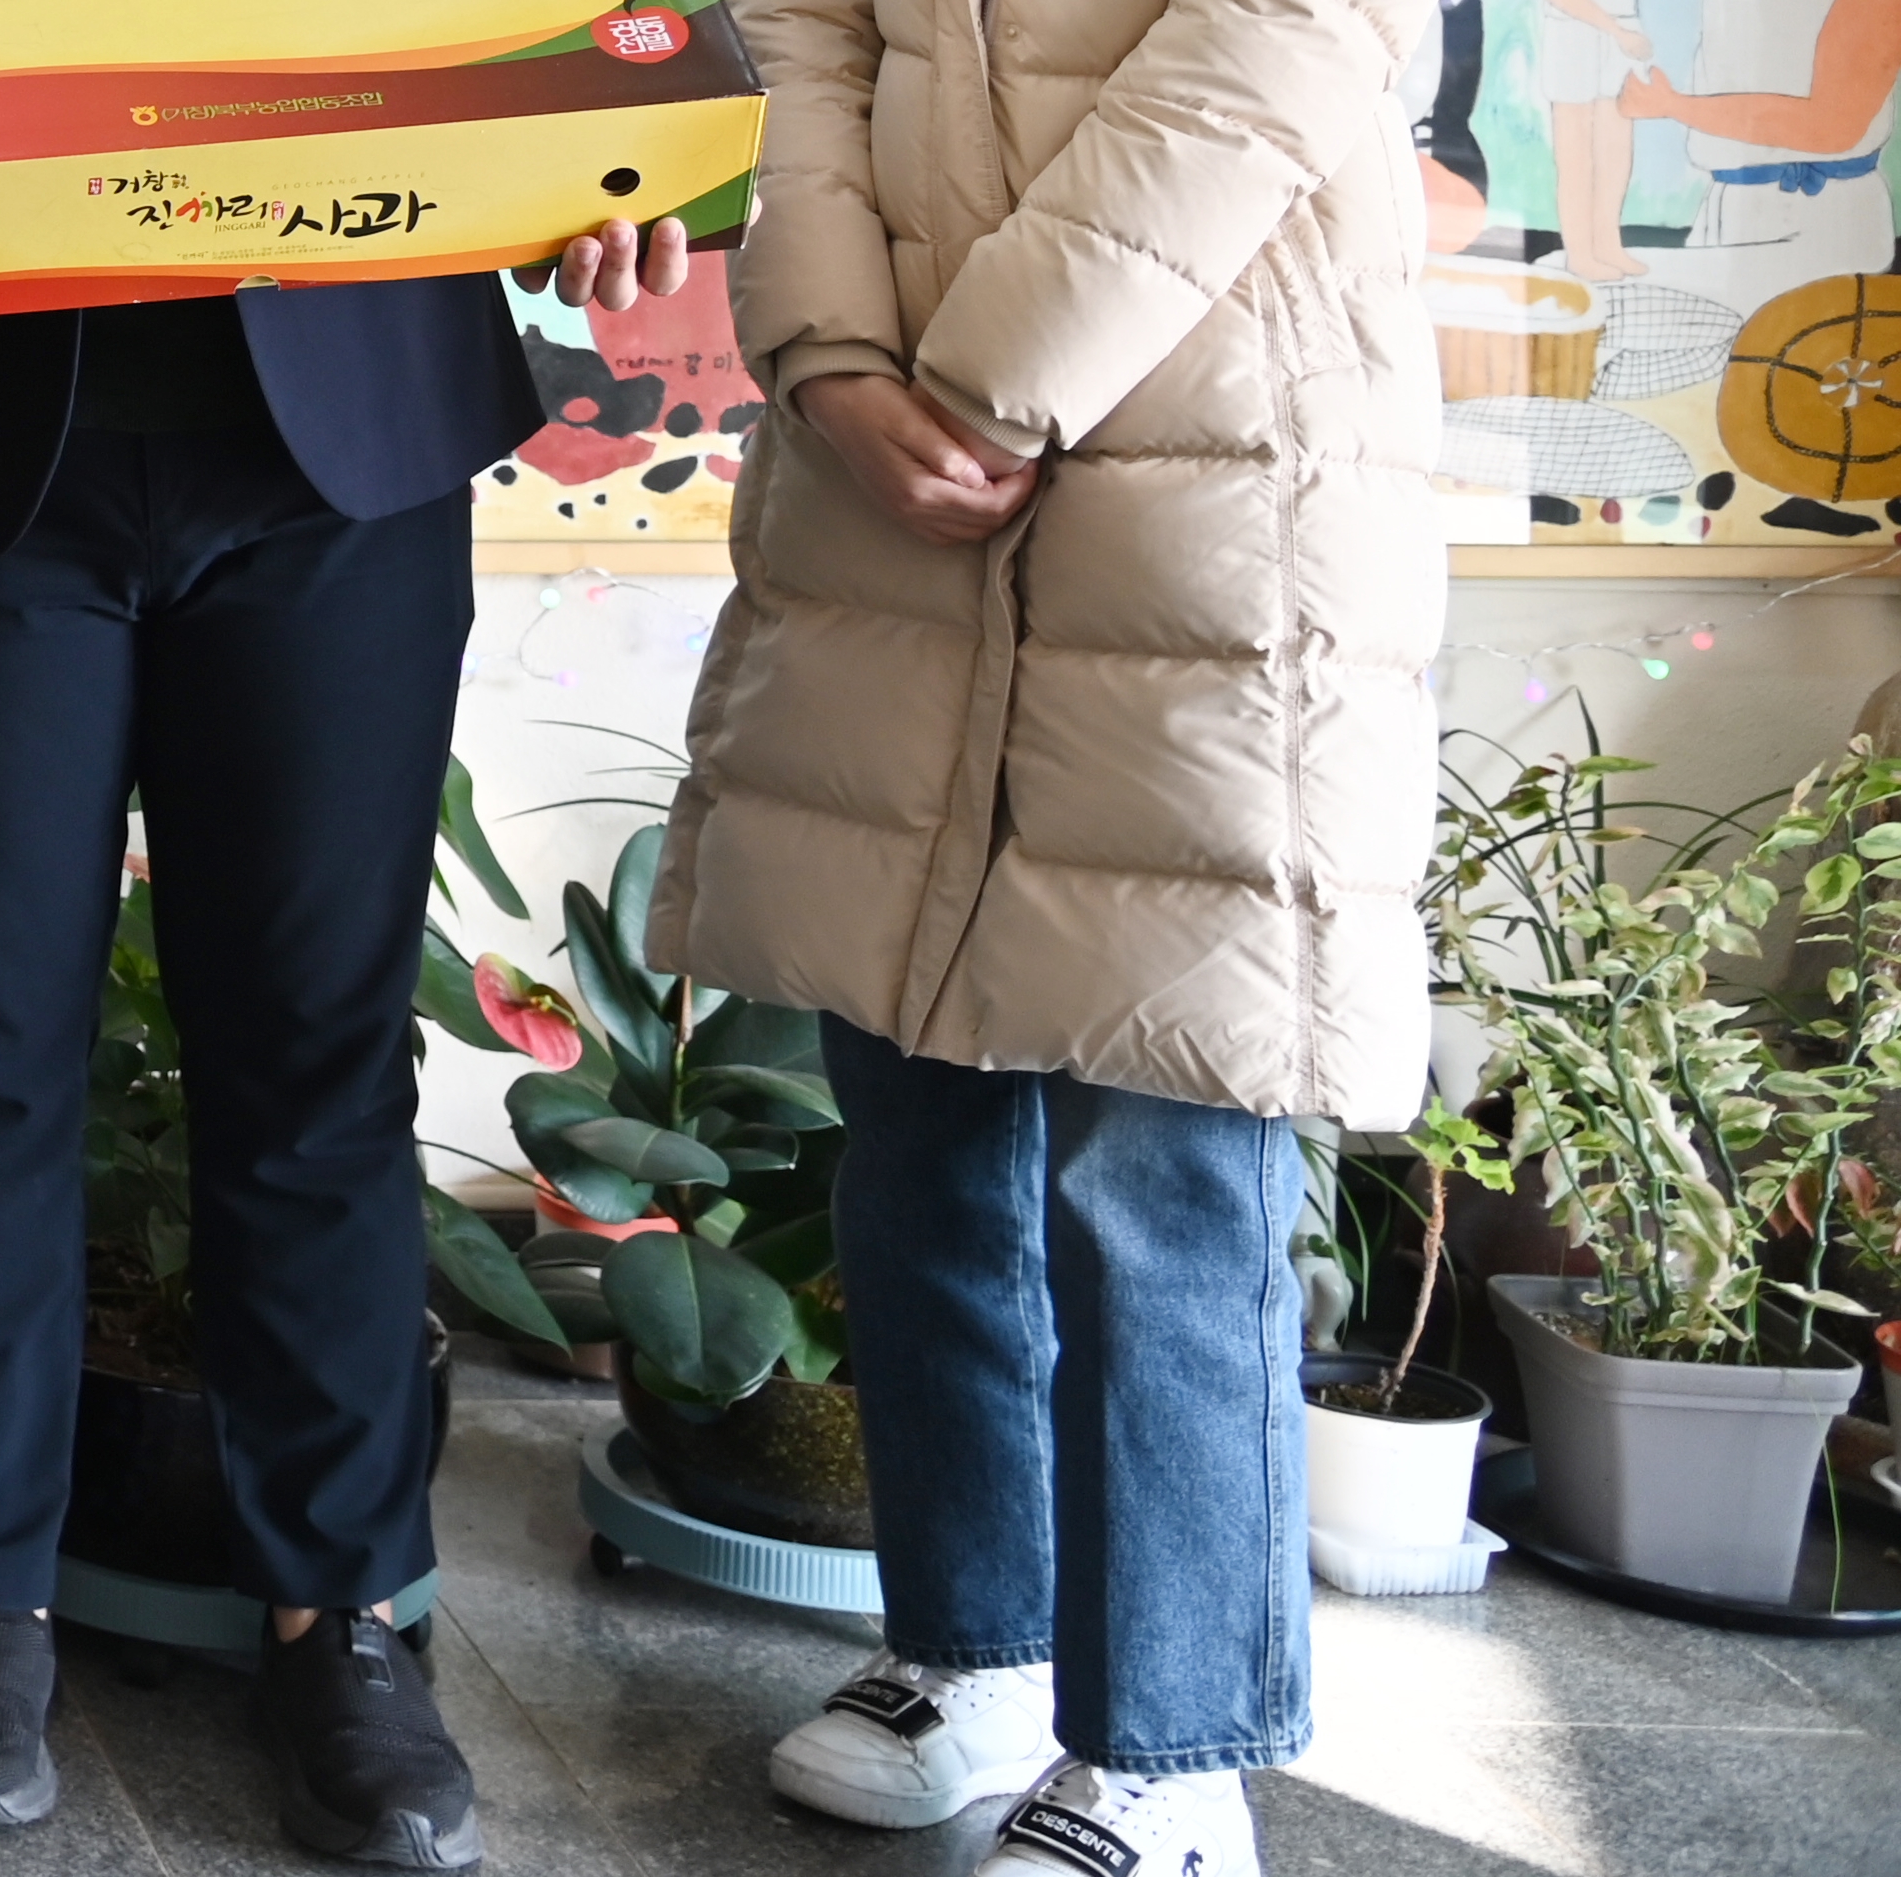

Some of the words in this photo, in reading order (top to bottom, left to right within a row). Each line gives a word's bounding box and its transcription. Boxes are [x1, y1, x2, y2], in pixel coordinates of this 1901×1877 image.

[607, 15, 666, 38] 공동
[614, 31, 675, 55] 선별
[271, 177, 358, 191] GEOCHANG
[366, 171, 426, 182] APPLE
[278, 189, 438, 238] 사과
[214, 221, 266, 234] JINGGARI
[1030, 1810, 1127, 1868] DESCENTE
